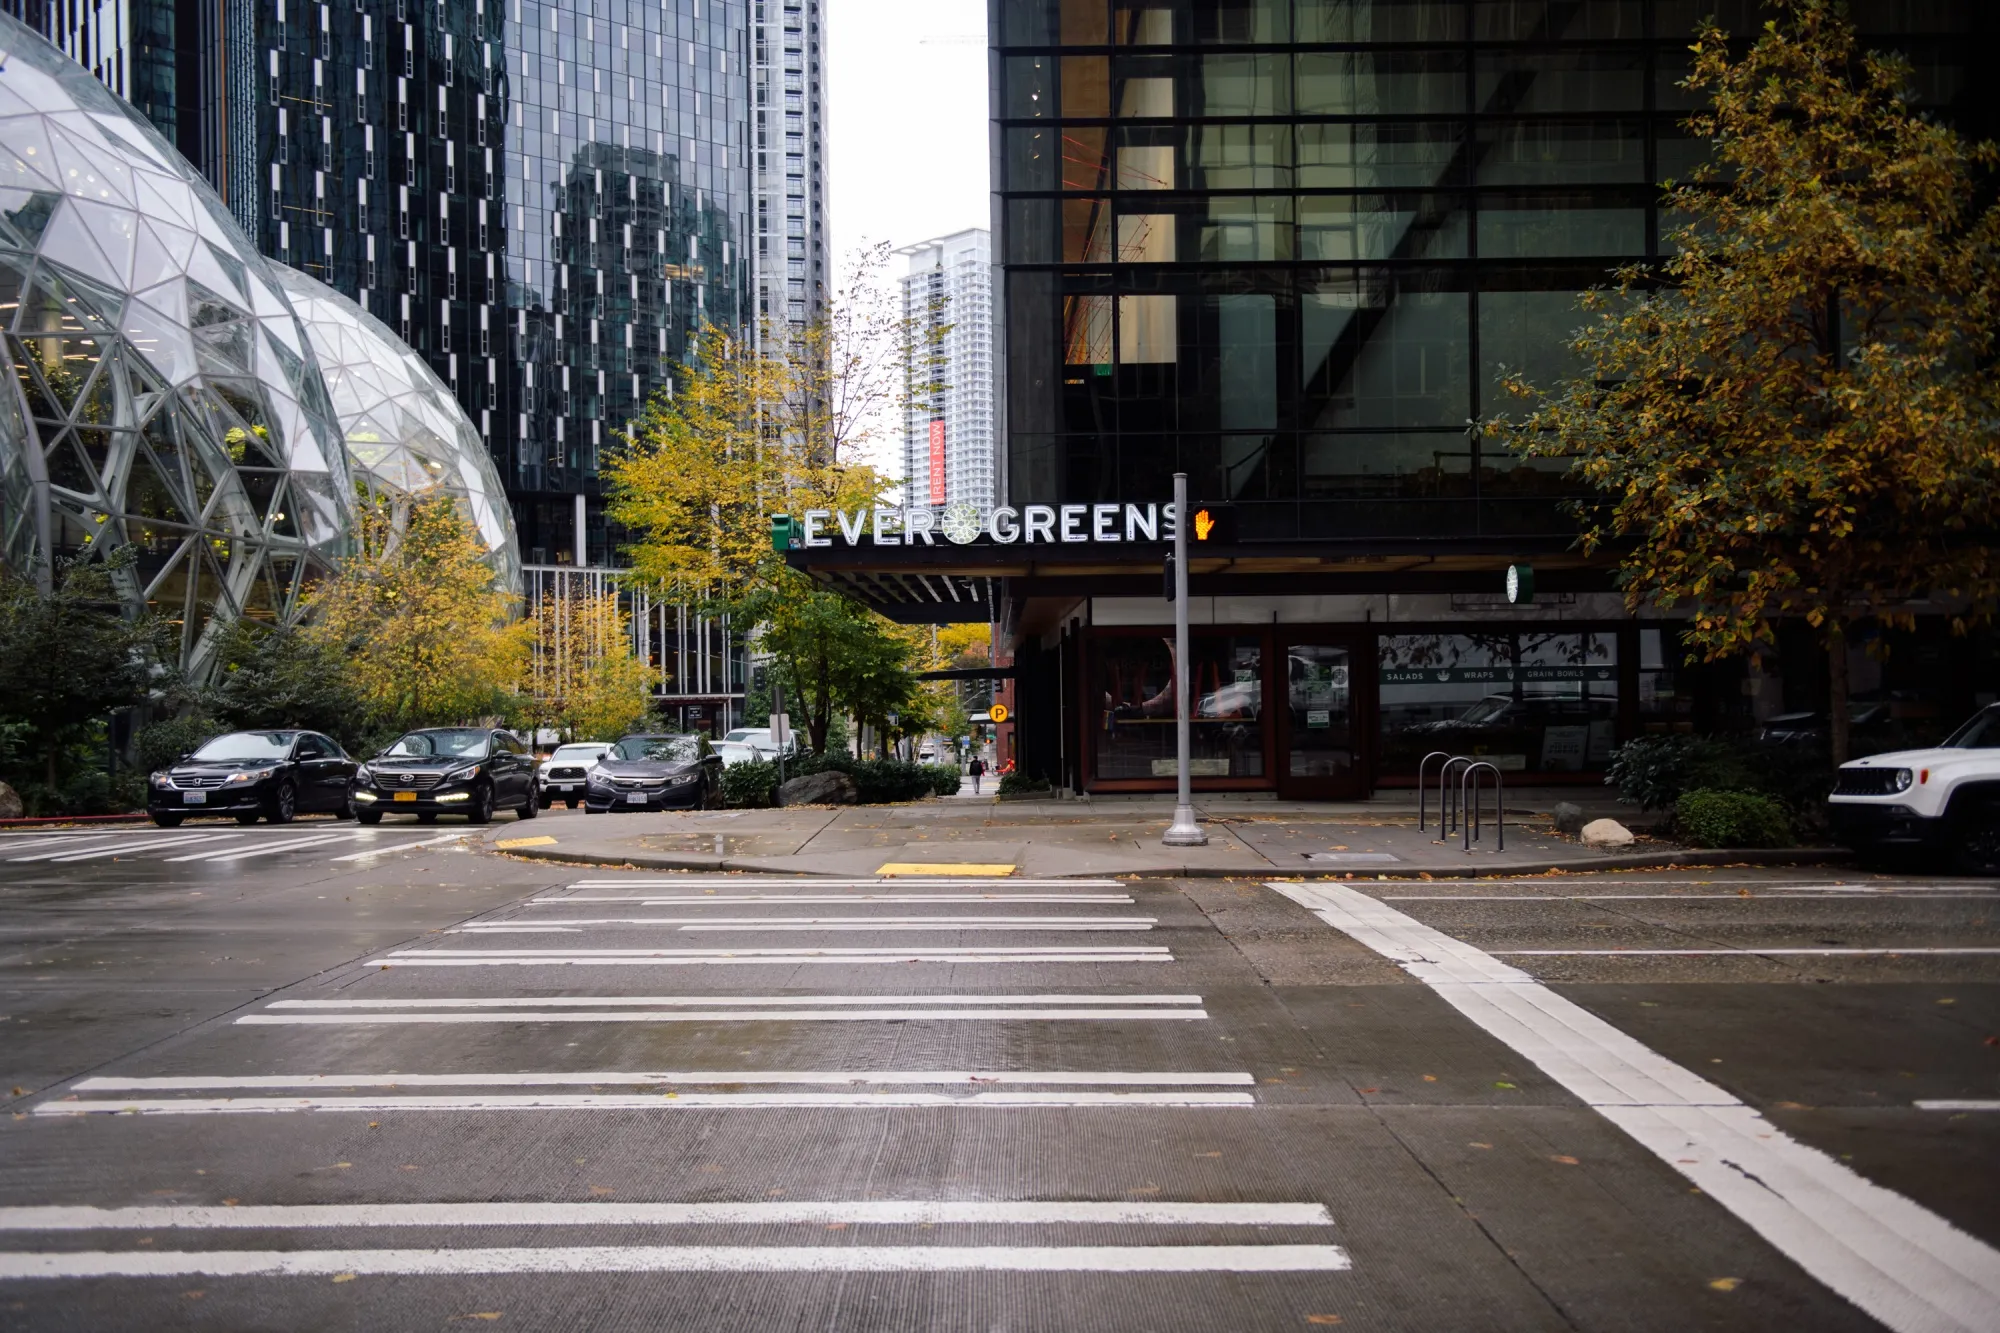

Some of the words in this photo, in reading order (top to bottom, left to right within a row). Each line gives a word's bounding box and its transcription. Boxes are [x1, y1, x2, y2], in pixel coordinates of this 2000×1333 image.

[932, 424, 942, 456] NOW
[932, 459, 942, 495] RENT
[804, 509, 935, 546] EVER
[1386, 672, 1424, 681] SALADS
[1463, 671, 1495, 680] WRAPS
[1527, 670, 1554, 679] GRAIN
[1556, 669, 1585, 678] BOWLS
[995, 708, 1004, 718] P
